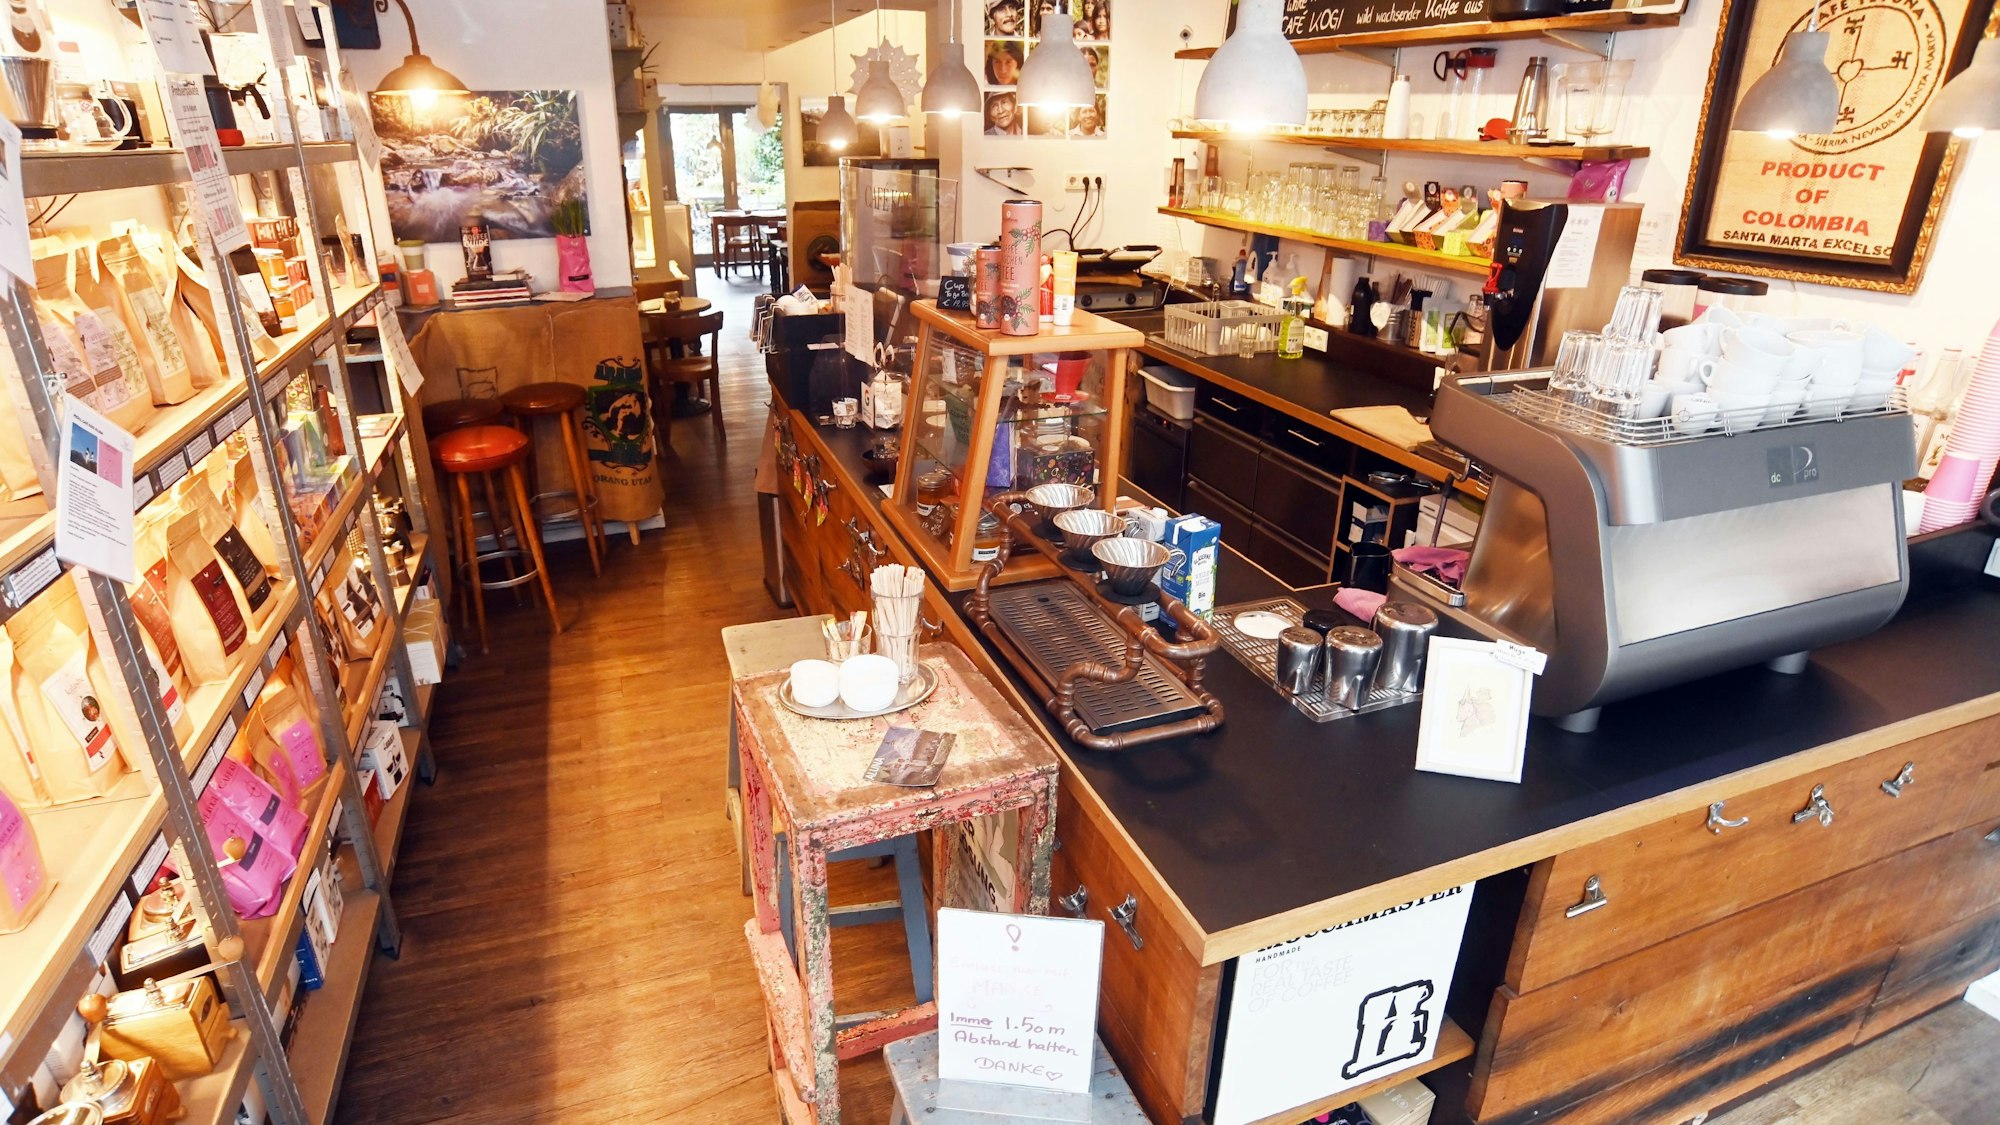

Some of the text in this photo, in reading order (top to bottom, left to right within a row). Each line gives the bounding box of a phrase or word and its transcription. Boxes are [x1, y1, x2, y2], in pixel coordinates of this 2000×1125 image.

[1308, 8, 1344, 33] KOGI
[1356, 6, 1375, 25] wild
[1376, 3, 1421, 24] wachsender
[1425, 0, 1459, 20] Kaffee
[1464, 0, 1484, 15] aus
[1815, 137, 1848, 147] SIERRA
[1851, 119, 1895, 144] NEVADA
[1905, 75, 1929, 108] SANTA
[1925, 31, 1936, 69] MARTA
[1760, 161, 1887, 181] PRODUCT
[1795, 189, 1830, 205] OF
[1742, 210, 1871, 237] COLOMBIA
[463, 239, 490, 248] GUIDE
[1722, 230, 1767, 243] SANTA
[1769, 236, 1819, 249] MARTA
[944, 280, 965, 292] Cup
[863, 389, 869, 406] G
[592, 475, 629, 487] ORANG
[1770, 468, 1817, 483] dc pro
[1254, 945, 1302, 964] HANDMADE
[1250, 954, 1353, 998] REAL TASTE
[1253, 959, 1294, 983] FOR
[1248, 968, 1354, 1013] OF COFFEE
[950, 1010, 1065, 1036] Immer 1.50 m
[954, 1029, 1080, 1057] Abstand halten
[974, 1057, 1046, 1076] DANKE
